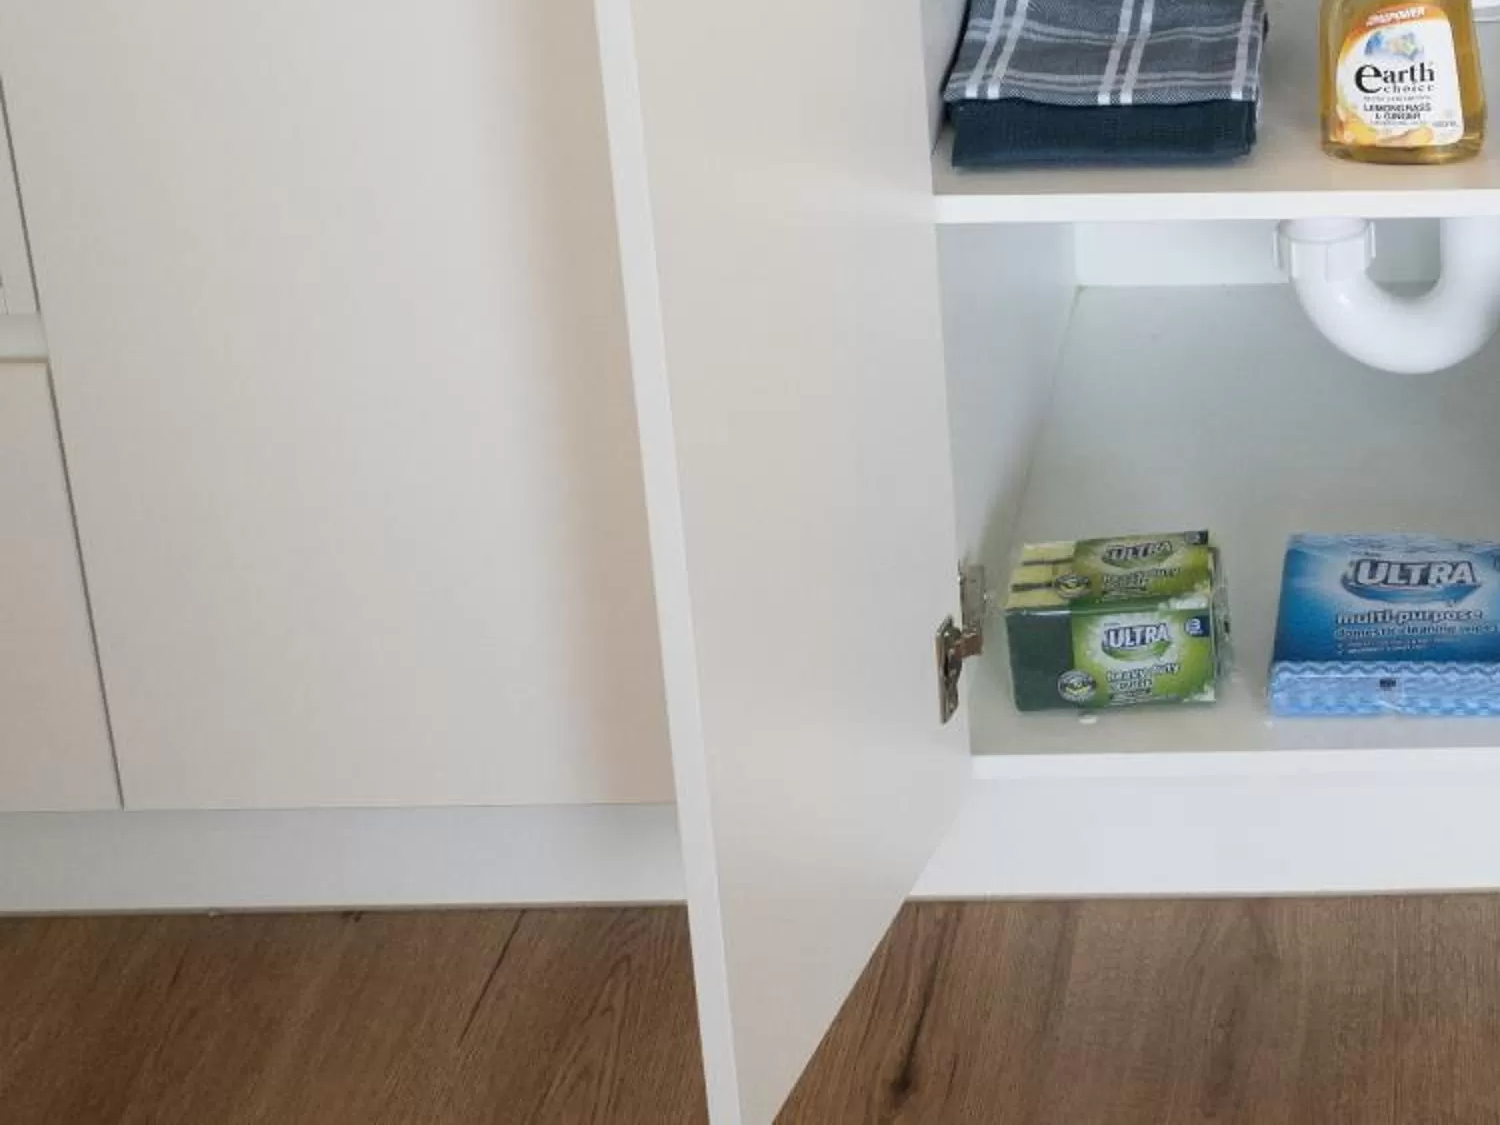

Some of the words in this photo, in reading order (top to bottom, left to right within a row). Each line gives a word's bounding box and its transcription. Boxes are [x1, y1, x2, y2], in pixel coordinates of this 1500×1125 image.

[1355, 62, 1435, 93] earth
[1384, 82, 1435, 93] choice
[1356, 559, 1477, 586] ULTRA
[1109, 623, 1170, 648] ULTRA
